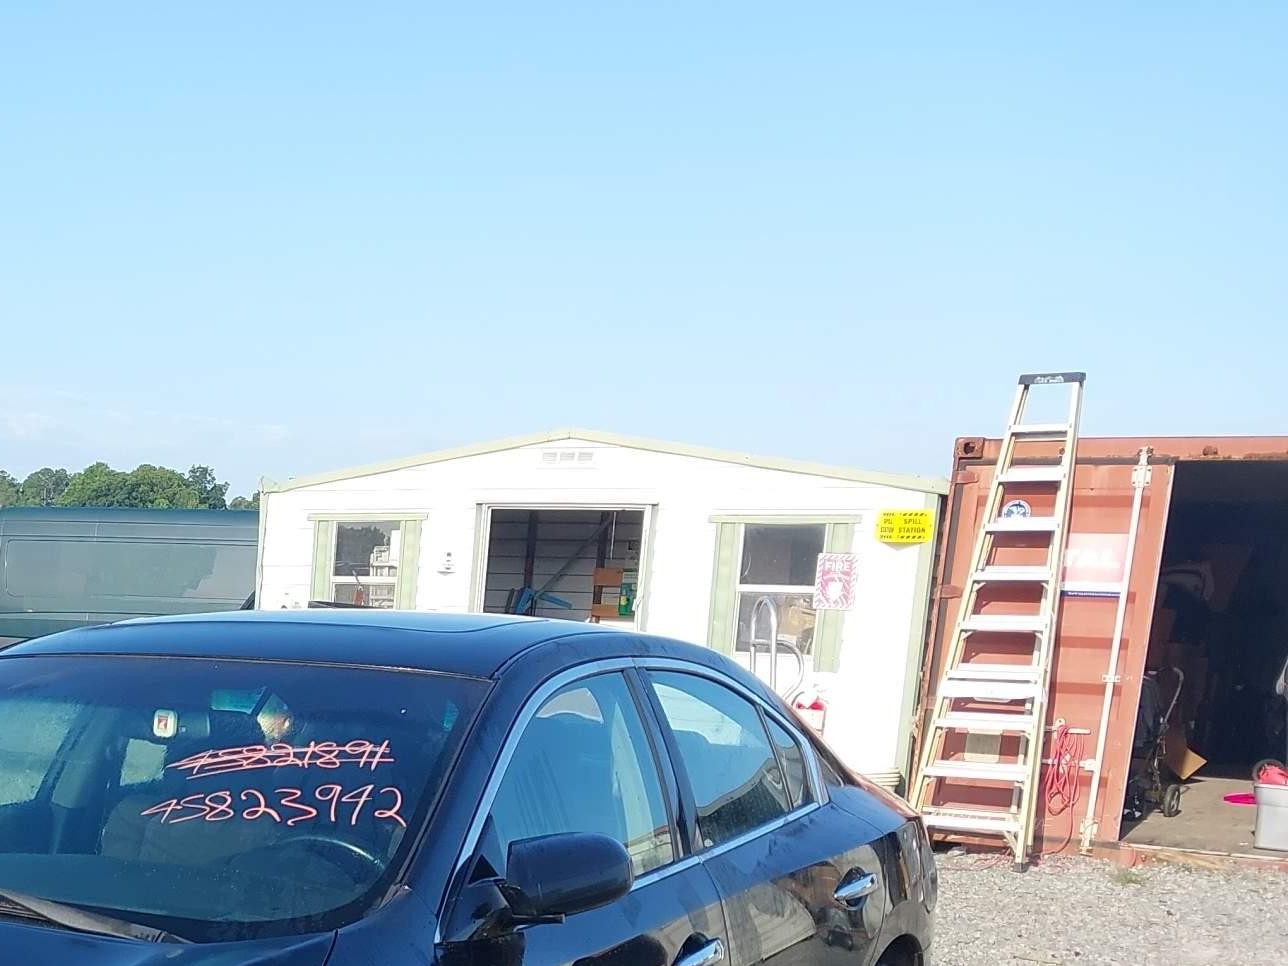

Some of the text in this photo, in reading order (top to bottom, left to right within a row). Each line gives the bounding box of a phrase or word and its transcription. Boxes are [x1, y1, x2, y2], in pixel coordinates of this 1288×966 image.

[898, 526, 926, 534] STATION
[824, 559, 851, 571] FIRE
[140, 783, 407, 828] 45823942
